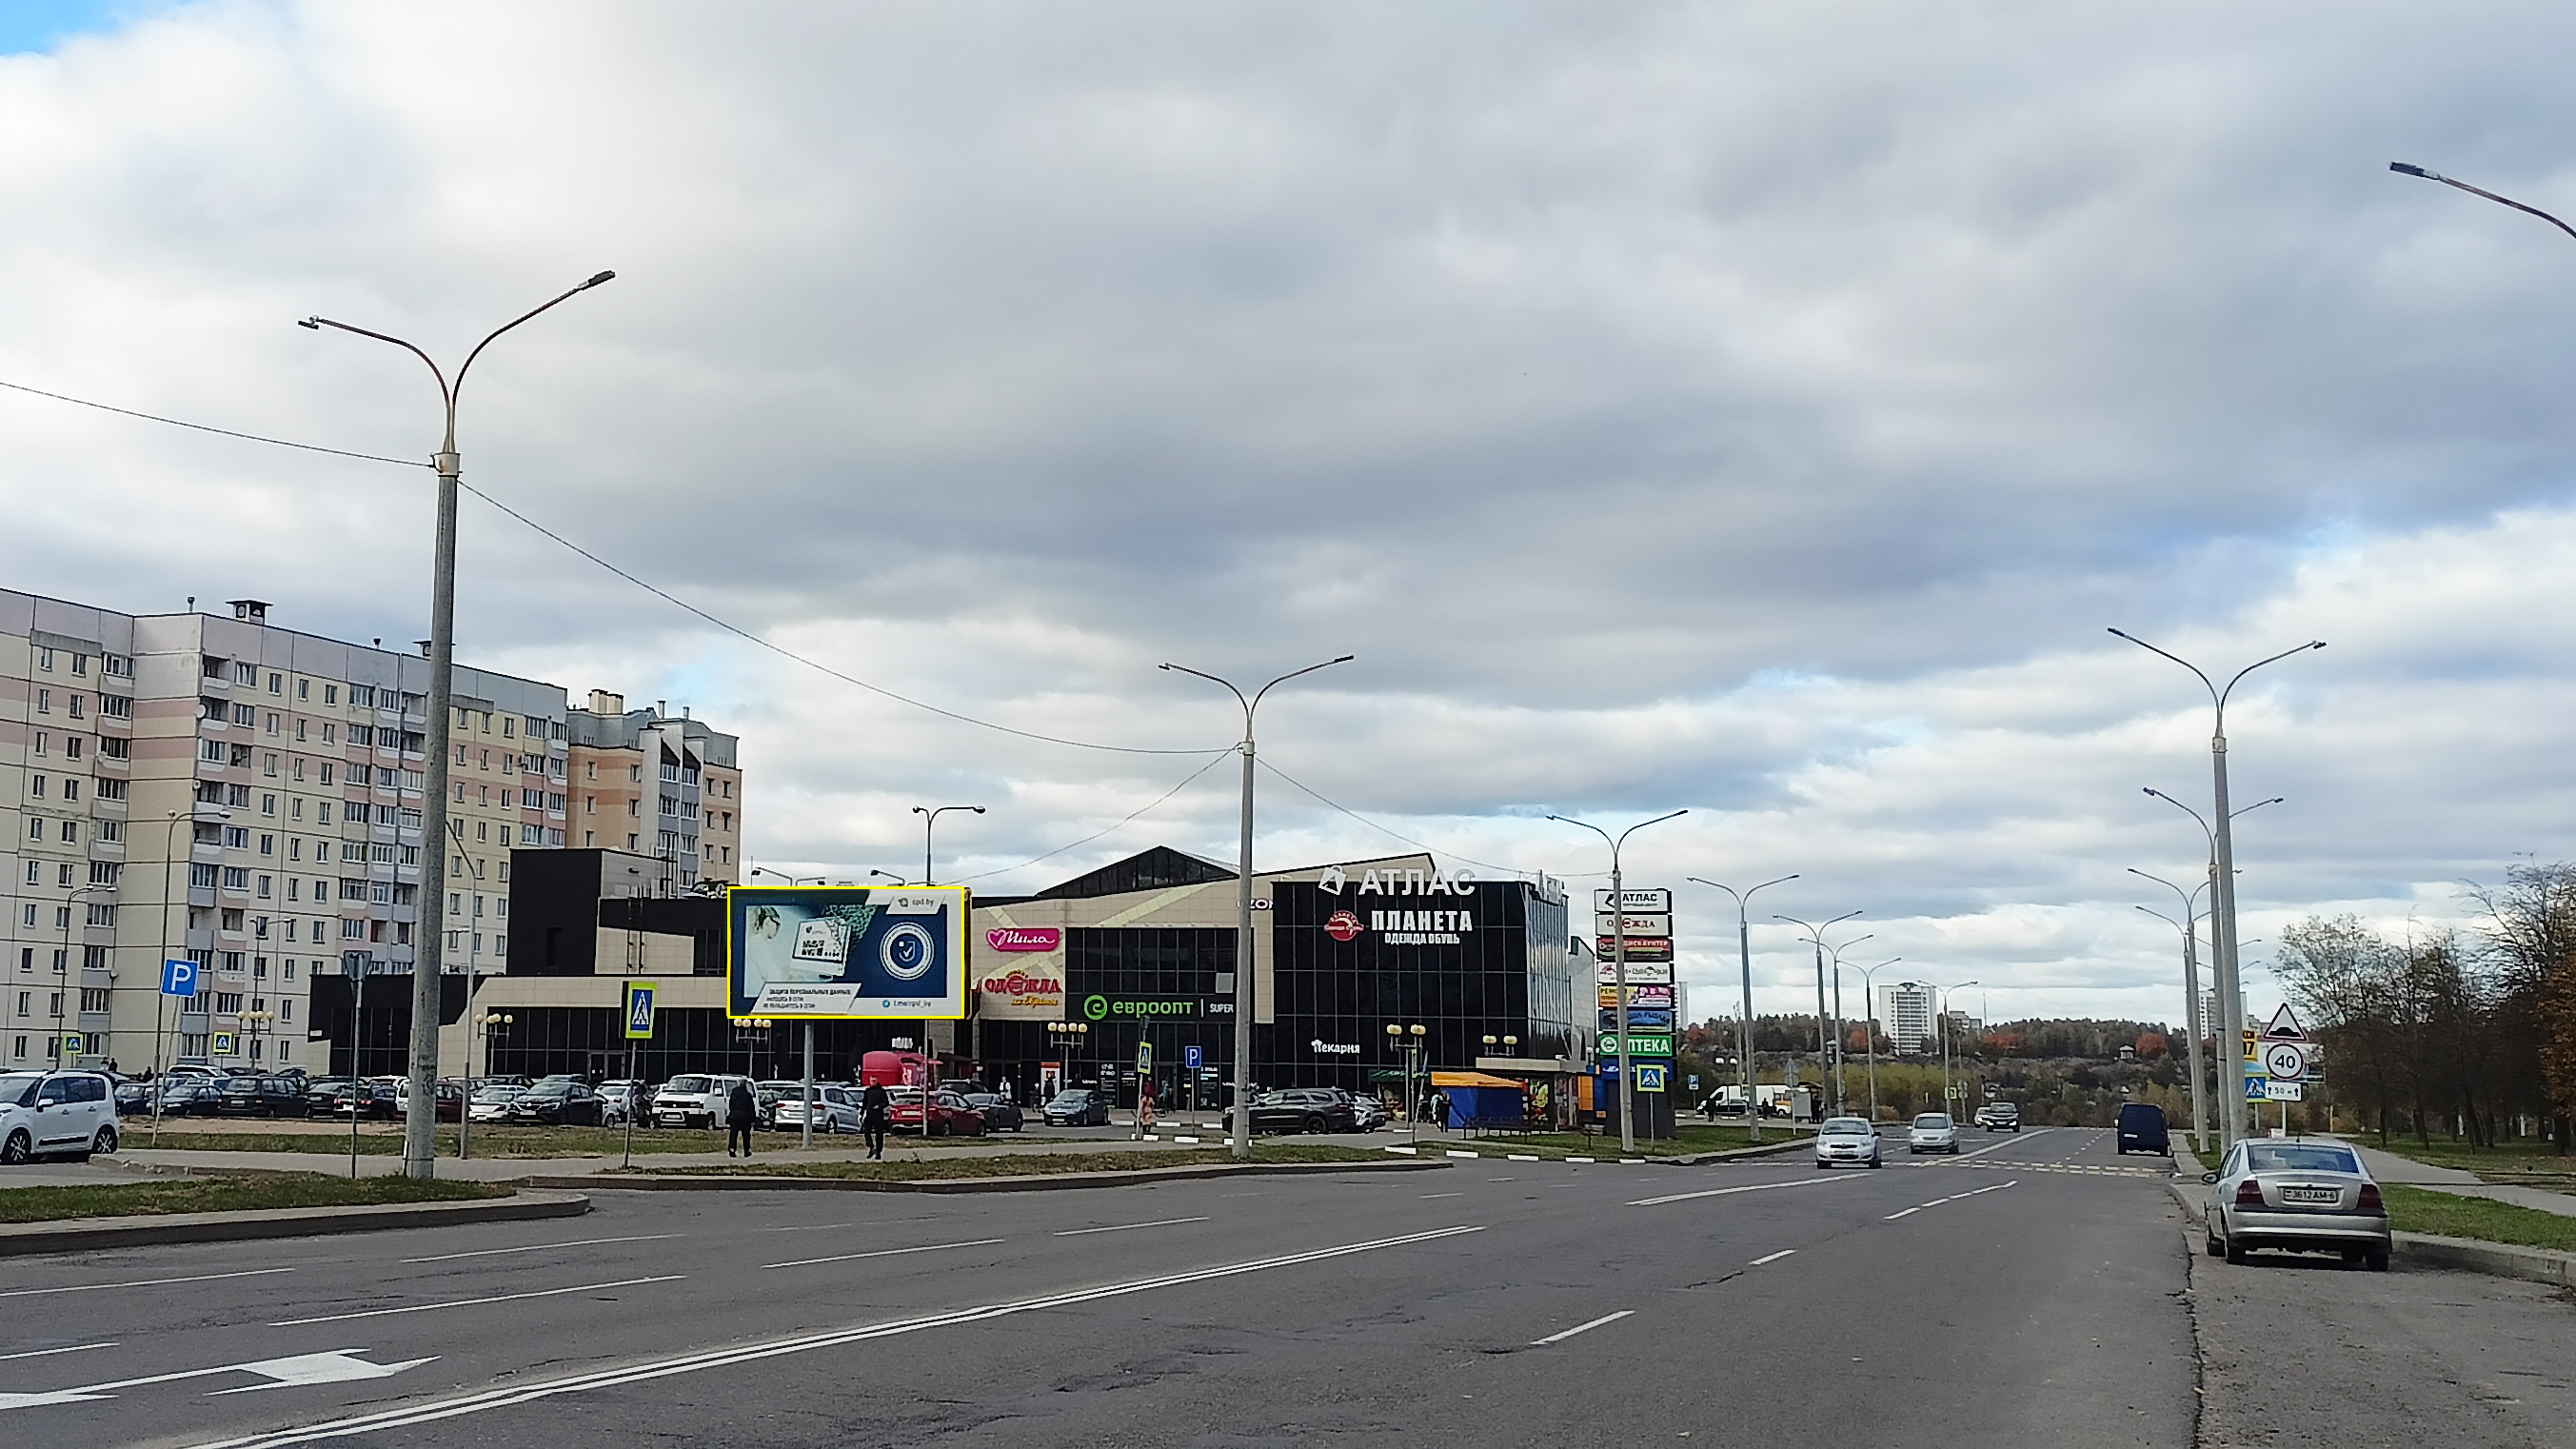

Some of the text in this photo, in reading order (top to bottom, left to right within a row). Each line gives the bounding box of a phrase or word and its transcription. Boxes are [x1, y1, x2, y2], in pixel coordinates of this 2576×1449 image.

[1358, 868, 1476, 896] АТЛАС
[1622, 893, 1658, 902] АТЛАС
[1371, 910, 1473, 932] ПЛАНЕТА
[1606, 917, 1655, 928] ОЕЖДА
[1003, 930, 1056, 944] Мила
[1384, 933, 1460, 945] ОДЕЖДА ОБУВЬ
[171, 963, 191, 991] P
[984, 975, 1063, 996] ОДЕЖДА
[1112, 1001, 1194, 1019] евроопт
[1209, 1002, 1234, 1014] SUPER
[1311, 1039, 1360, 1054] Пекарня
[1618, 1039, 1670, 1052] ПТЕКА
[2274, 1054, 2296, 1069] 40
